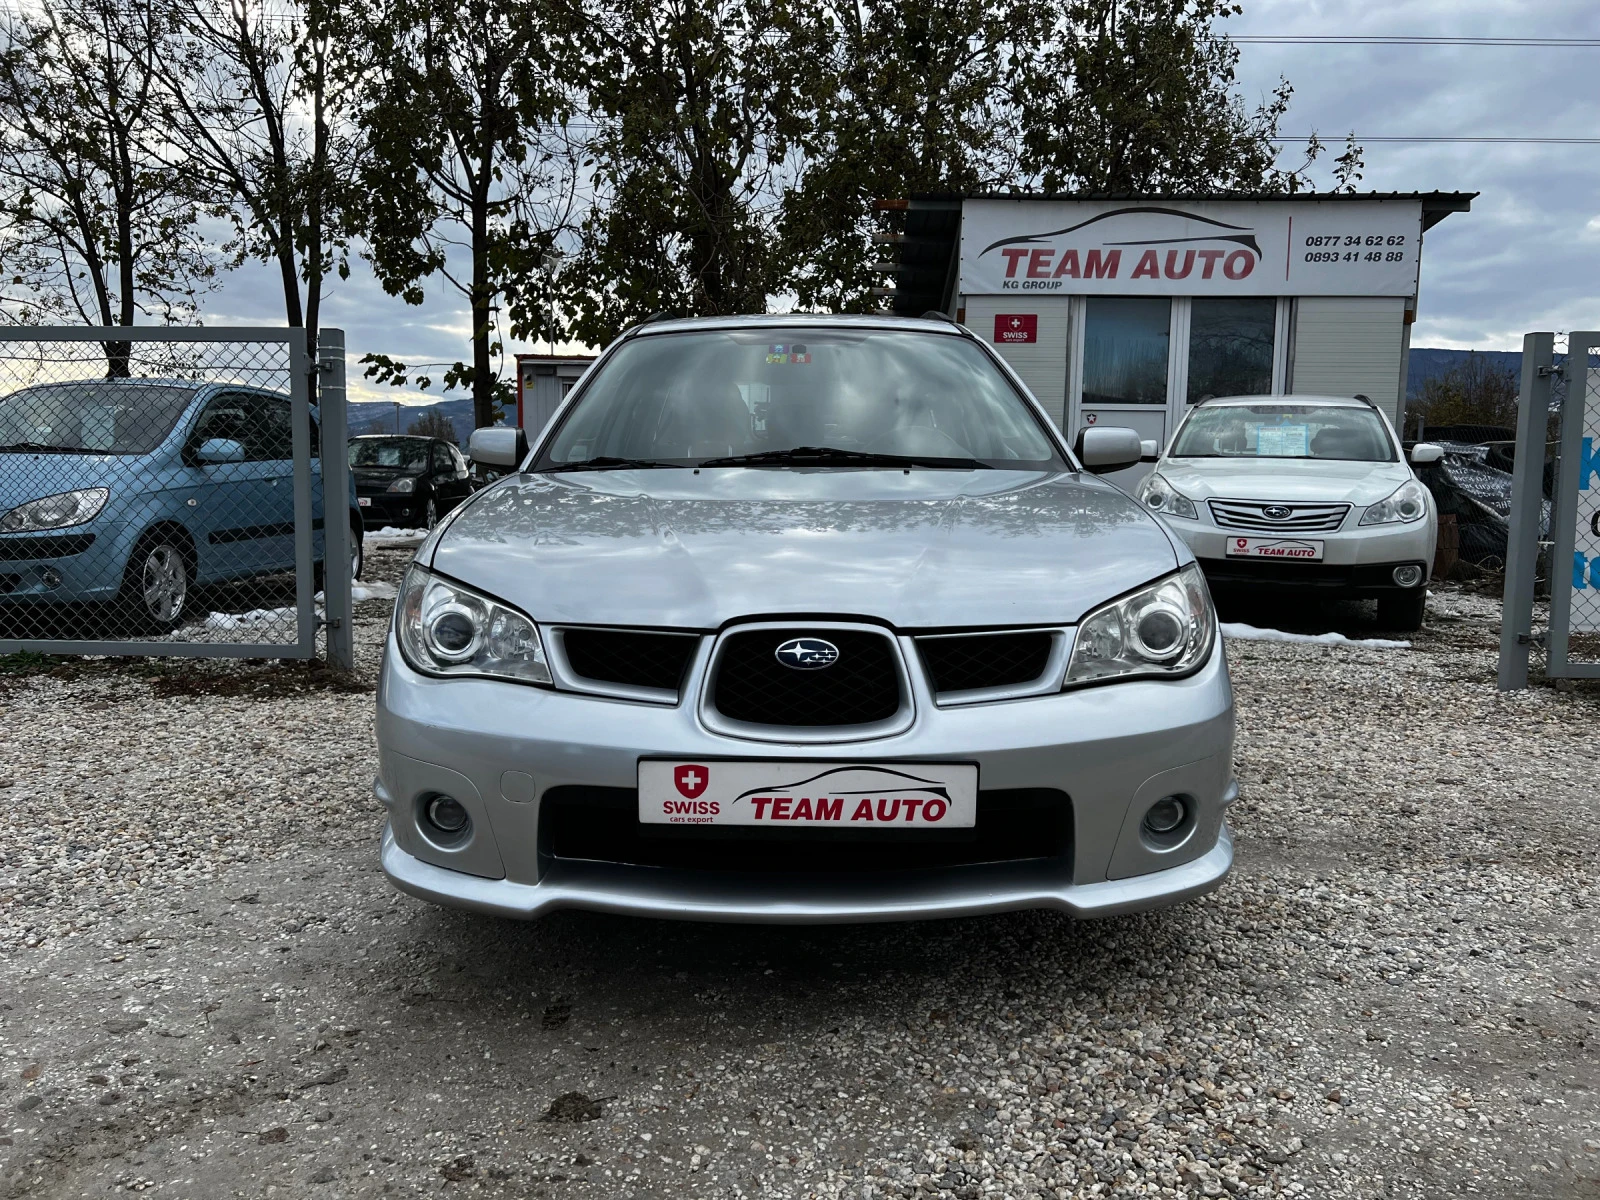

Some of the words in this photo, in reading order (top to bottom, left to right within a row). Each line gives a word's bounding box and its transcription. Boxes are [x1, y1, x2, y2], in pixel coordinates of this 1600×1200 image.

[1305, 235, 1341, 247] 0877
[1343, 235, 1362, 246] 34
[1365, 235, 1384, 246] 62
[1386, 235, 1405, 246] 62
[1304, 251, 1340, 262] 0893
[1342, 251, 1360, 262] 41
[1363, 251, 1382, 262] 48
[1385, 251, 1404, 262] 88
[1001, 248, 1122, 279] TEAM
[1130, 249, 1255, 281] AUTO
[1002, 280, 1019, 290] KG
[1022, 280, 1063, 290] GROUP
[1002, 331, 1028, 339] SWISS
[1257, 547, 1285, 556] TEAM
[1286, 549, 1315, 557] AUTO
[663, 800, 721, 815] SWISS
[750, 797, 845, 821] TEAM
[851, 798, 947, 822] AUTO
[687, 816, 714, 825] export
